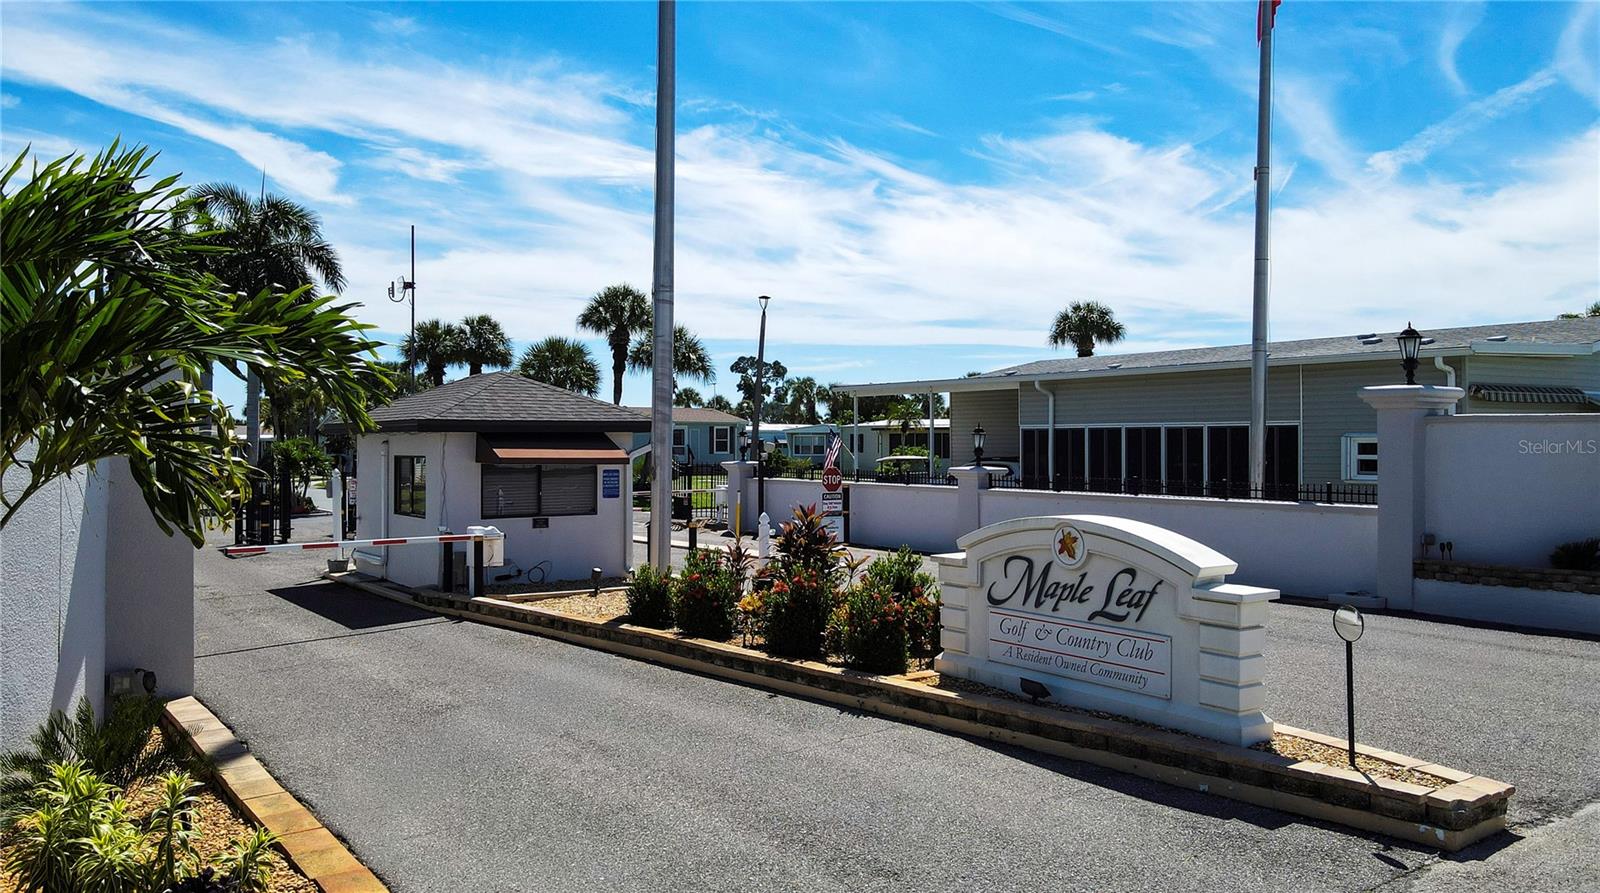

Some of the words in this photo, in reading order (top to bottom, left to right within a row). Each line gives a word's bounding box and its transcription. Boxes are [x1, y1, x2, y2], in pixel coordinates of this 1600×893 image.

[823, 475, 841, 485] STOP
[987, 555, 1095, 612] Maple
[1087, 567, 1164, 623] Leaf
[999, 617, 1030, 643] Golf
[1034, 624, 1053, 641] &
[1056, 627, 1112, 659] Country
[1116, 638, 1154, 662] Club
[1002, 646, 1014, 657] A
[1016, 649, 1052, 666] Resident
[1054, 655, 1088, 673] Owned
[1089, 663, 1149, 689] Community
